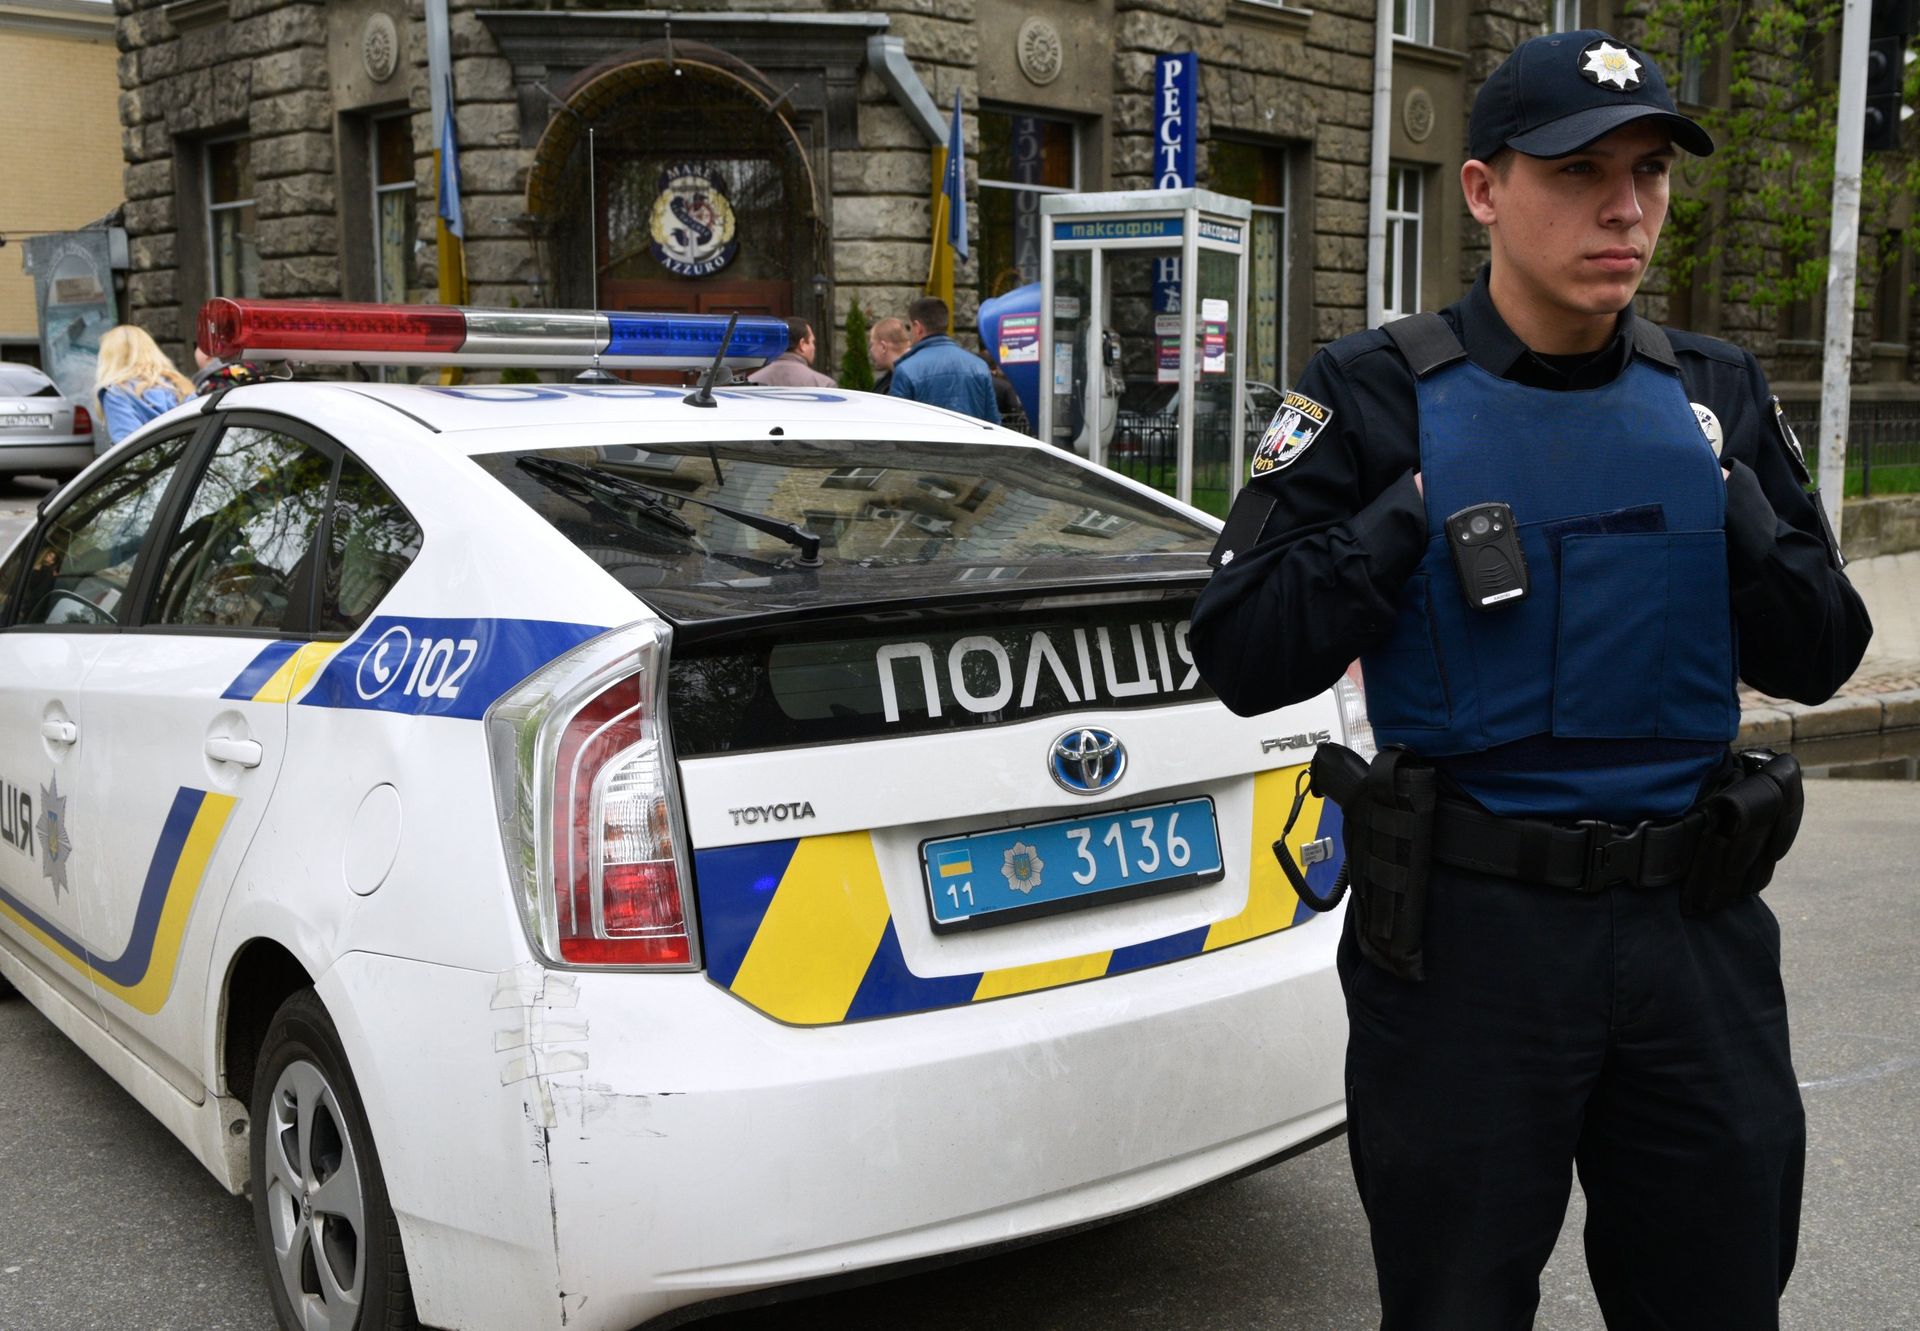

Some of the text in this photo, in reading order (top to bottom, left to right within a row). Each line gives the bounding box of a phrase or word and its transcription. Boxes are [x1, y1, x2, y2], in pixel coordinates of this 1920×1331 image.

[1072, 221, 1164, 237] таксофон
[662, 256, 725, 275] AZZURO
[403, 638, 478, 699] 102
[1261, 730, 1331, 754] PRIUS
[728, 801, 816, 826] TOYOTA
[1066, 812, 1191, 886] 3136
[947, 881, 974, 909] 11
